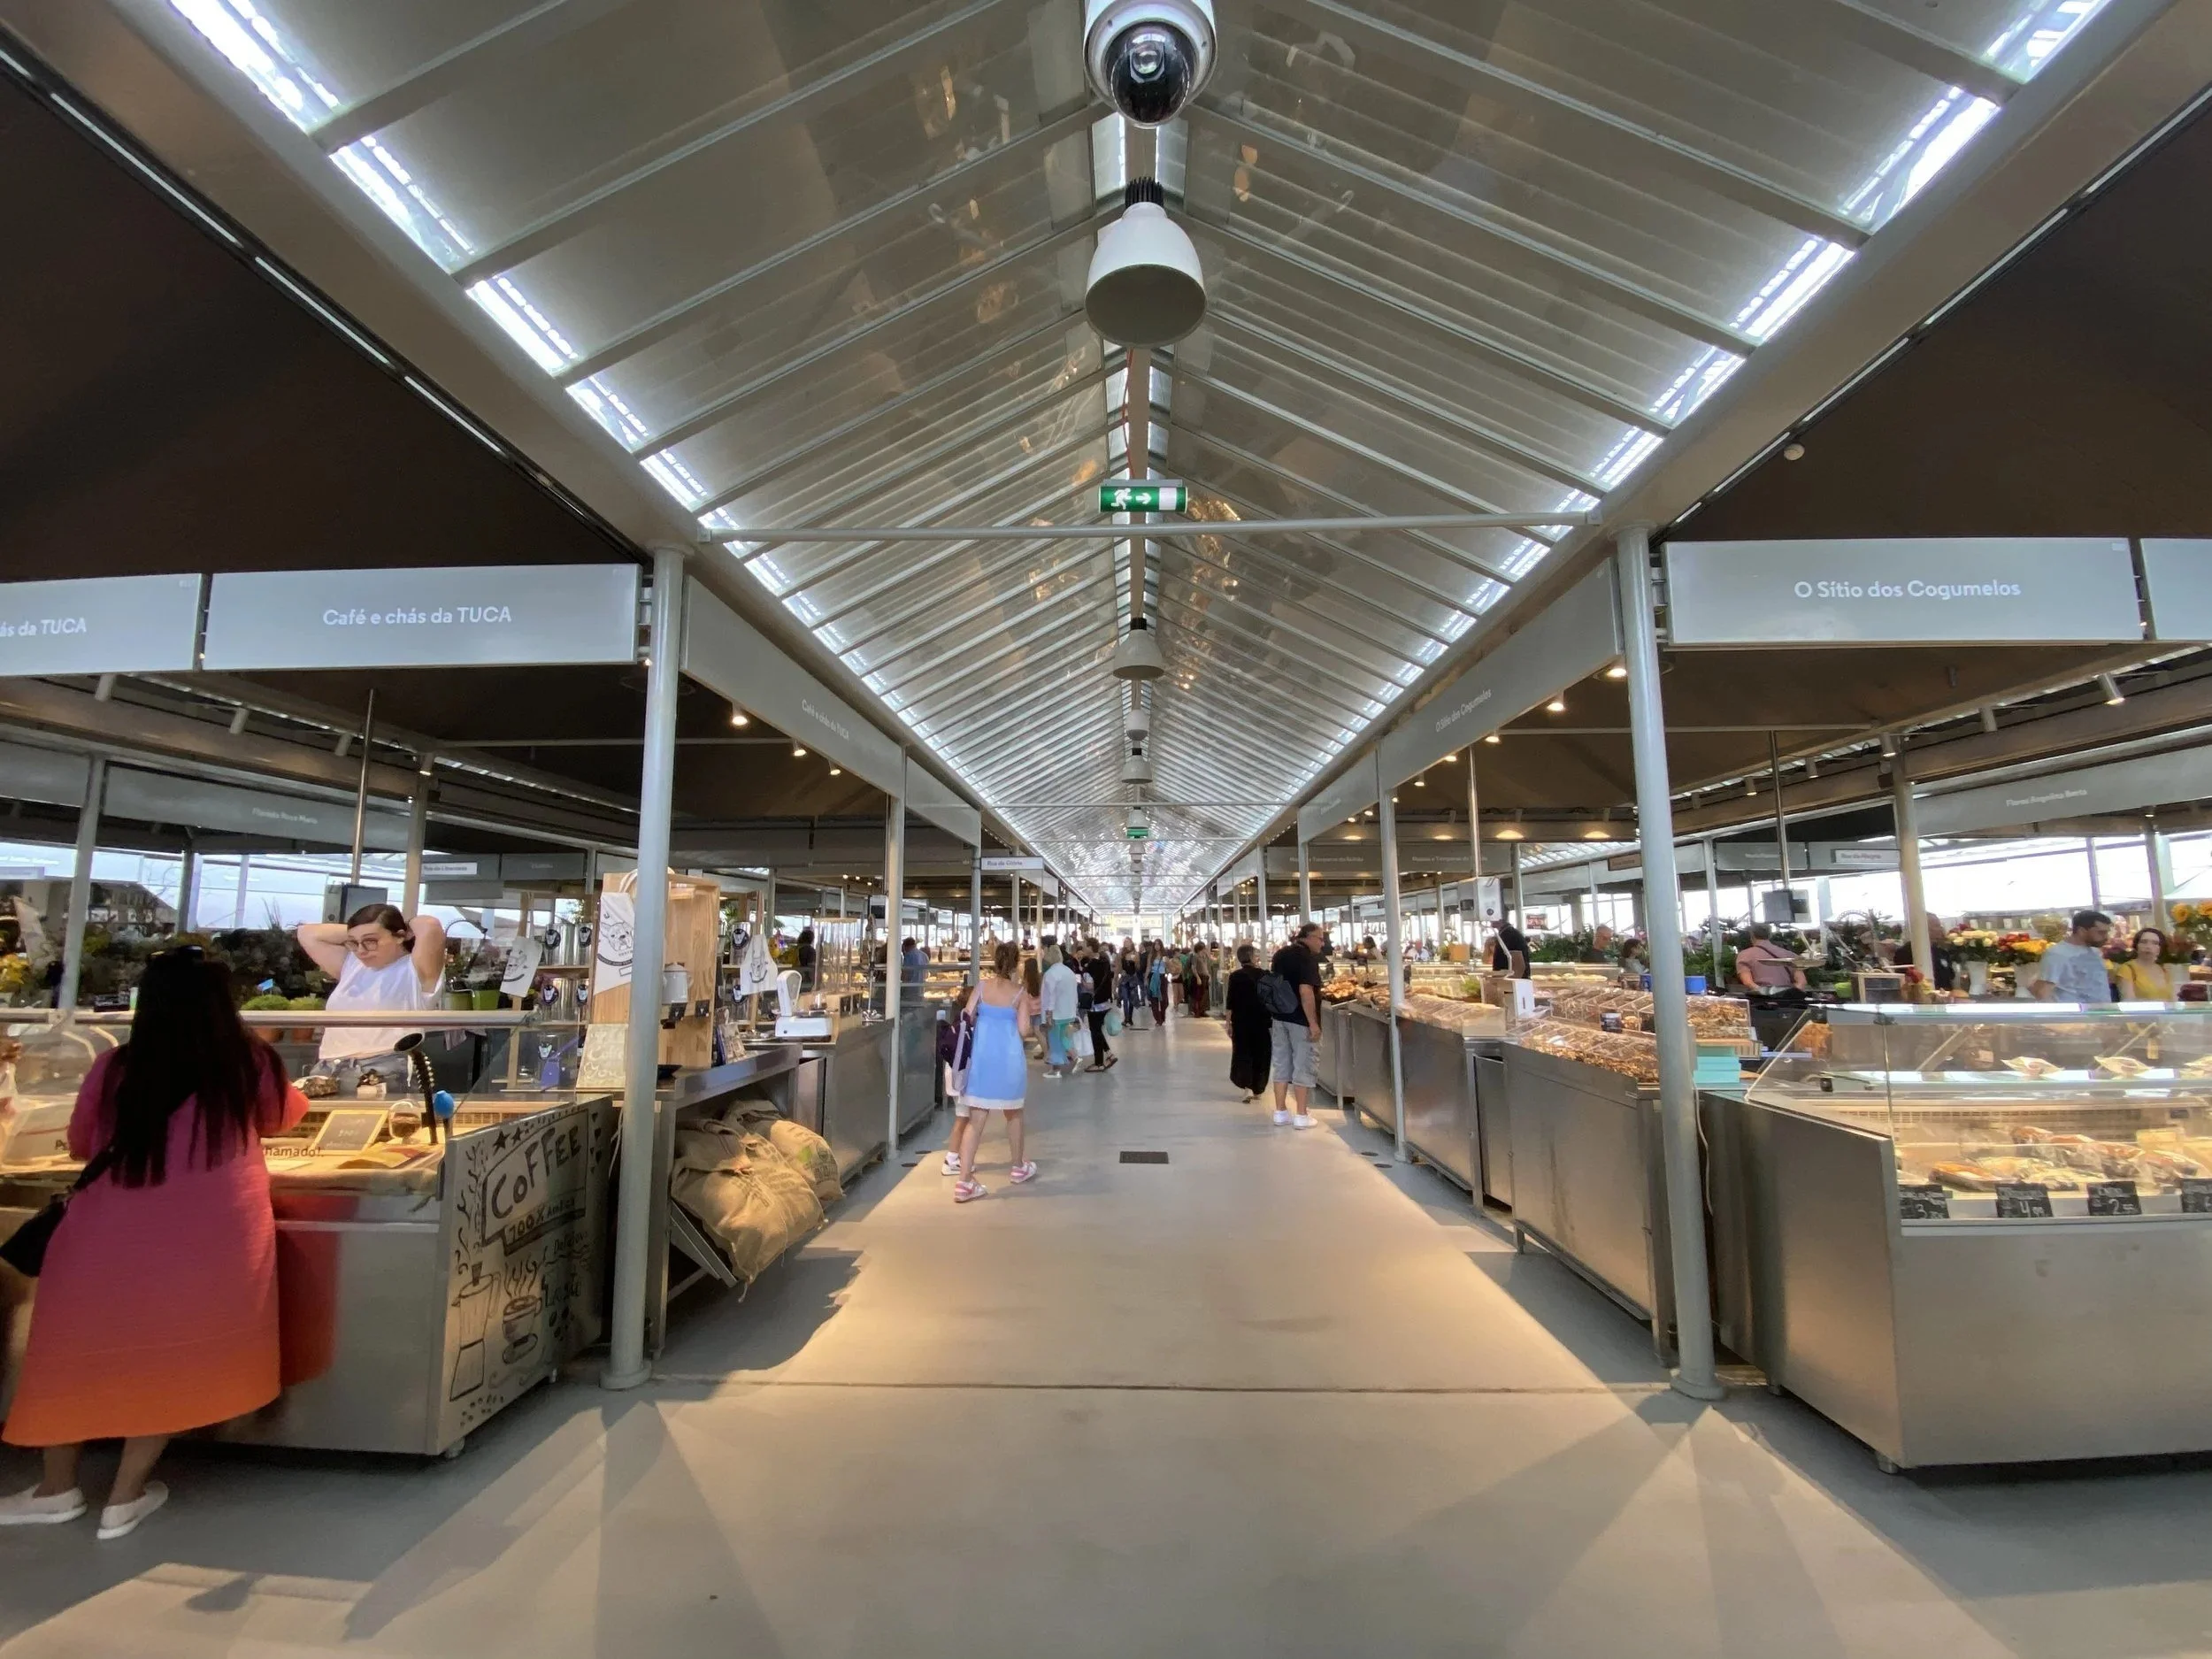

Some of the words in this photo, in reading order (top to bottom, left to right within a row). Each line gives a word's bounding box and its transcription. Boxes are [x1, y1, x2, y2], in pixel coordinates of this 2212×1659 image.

[1793, 580, 1813, 599] O
[1816, 580, 1863, 599] Sítio
[1867, 580, 1904, 598] dos
[1907, 579, 2023, 601] Cogumelos
[322, 608, 366, 626] Café
[369, 611, 382, 625] e
[385, 607, 426, 625] chás
[430, 606, 454, 624] da
[456, 605, 513, 624] TUCA
[18, 622, 37, 636] da
[42, 617, 88, 635] TUCA
